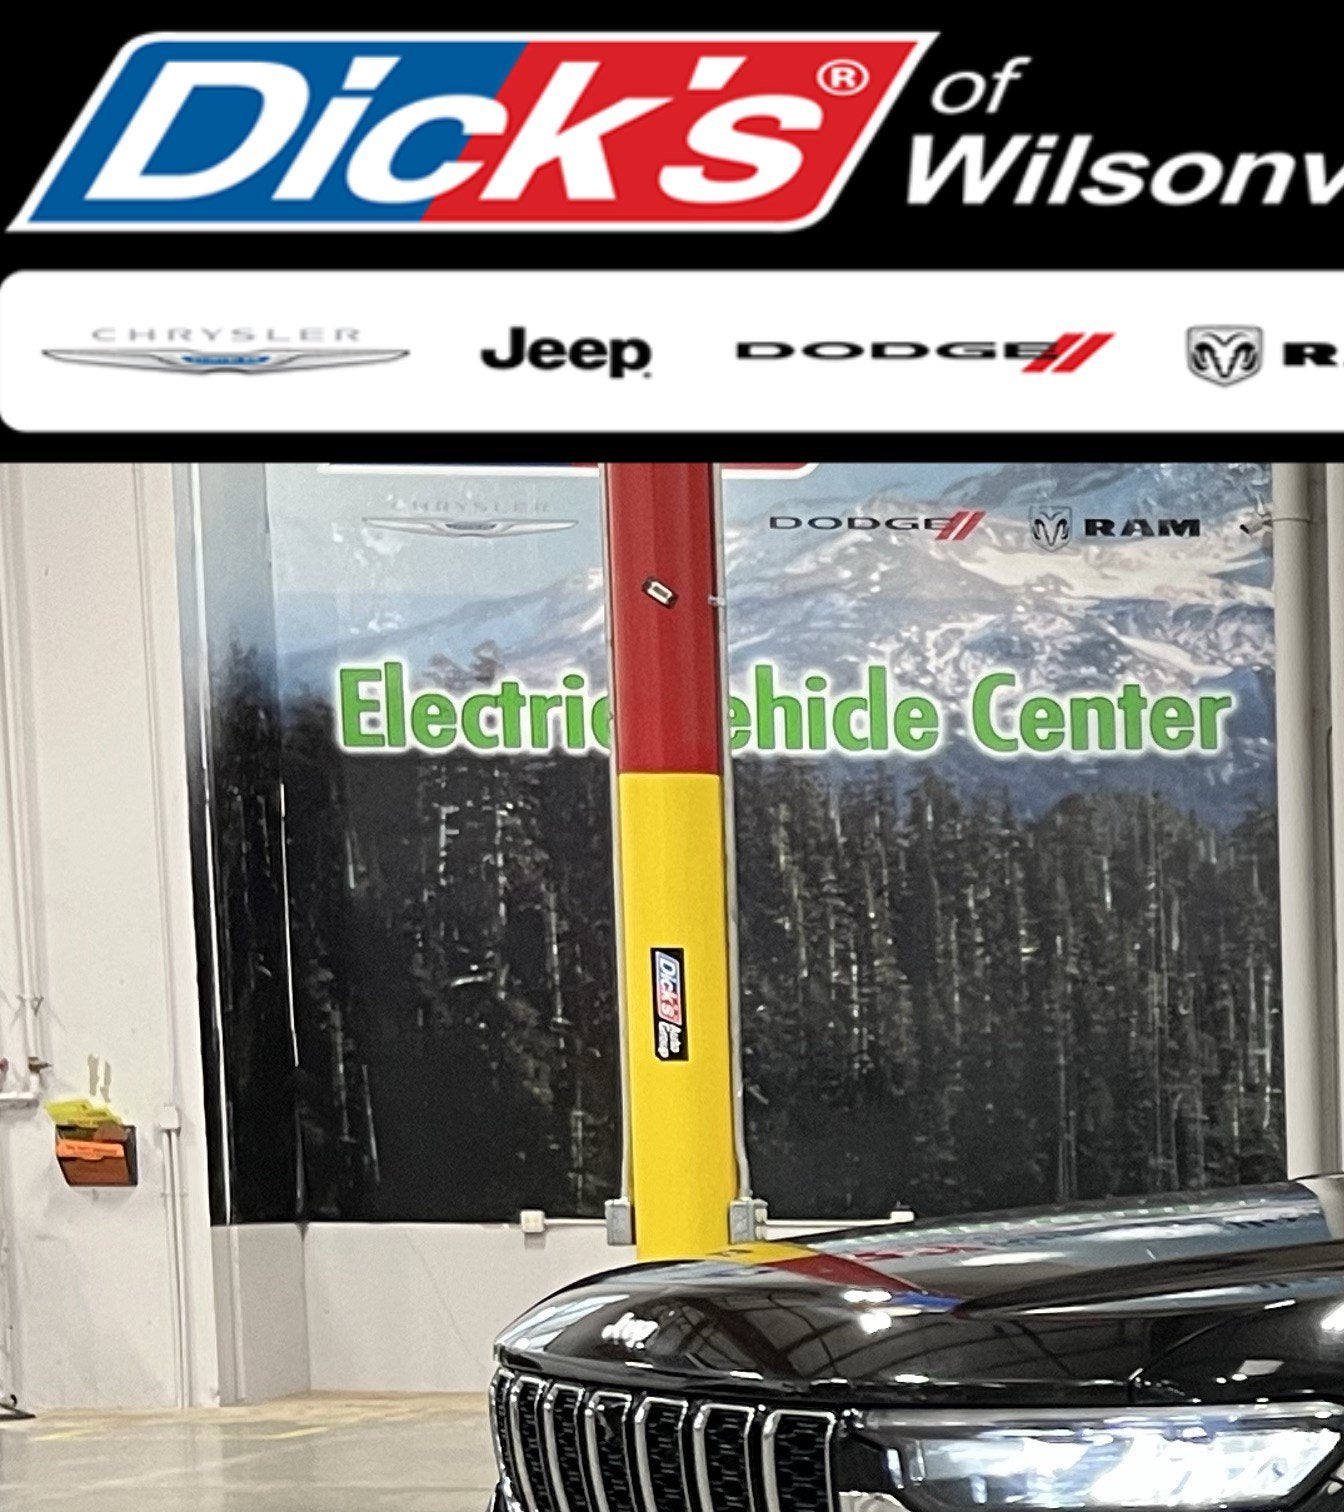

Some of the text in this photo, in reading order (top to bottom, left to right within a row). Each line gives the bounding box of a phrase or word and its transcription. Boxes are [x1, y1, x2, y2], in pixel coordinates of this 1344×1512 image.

[769, 516, 952, 531] DODGE
[1084, 518, 1200, 538] RAM
[728, 664, 938, 751] ehicle
[973, 673, 1232, 752] Center
